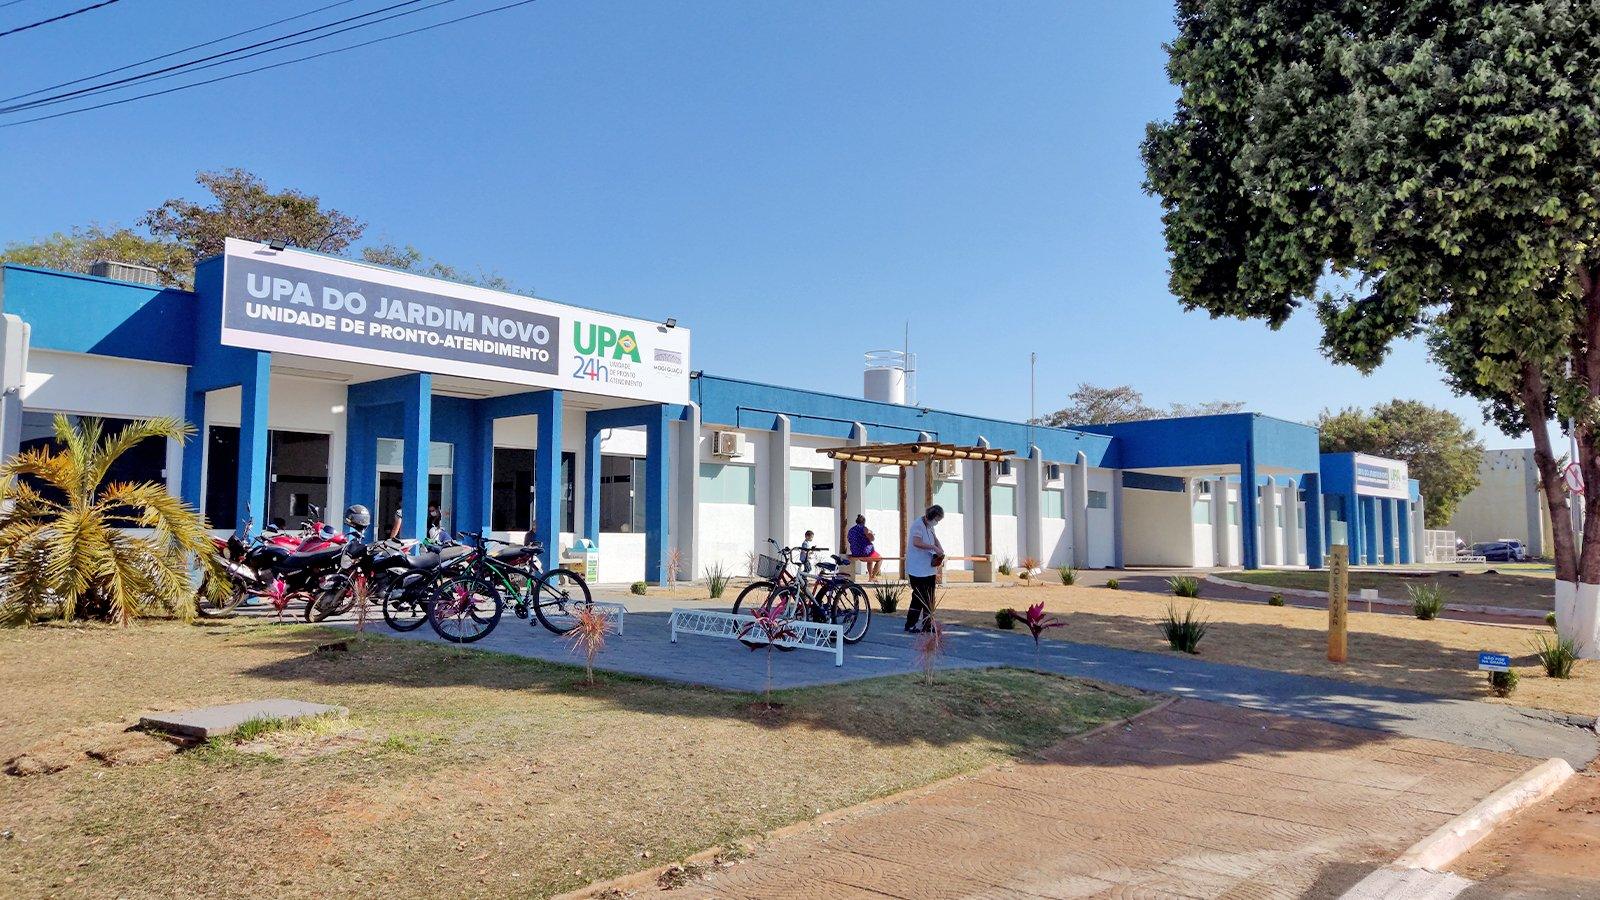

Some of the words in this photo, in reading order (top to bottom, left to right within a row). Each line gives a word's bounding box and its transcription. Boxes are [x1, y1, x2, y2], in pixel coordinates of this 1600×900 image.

[245, 302, 336, 331] UNIDADE
[340, 317, 365, 335] DE
[369, 322, 549, 363] PRONTO-ATENDIMENTO
[247, 273, 314, 307] UPA
[322, 286, 367, 315] DO
[374, 297, 475, 333] JARDIM
[481, 315, 550, 345] NOVO
[573, 320, 642, 363] UPA
[573, 355, 609, 383] 24h
